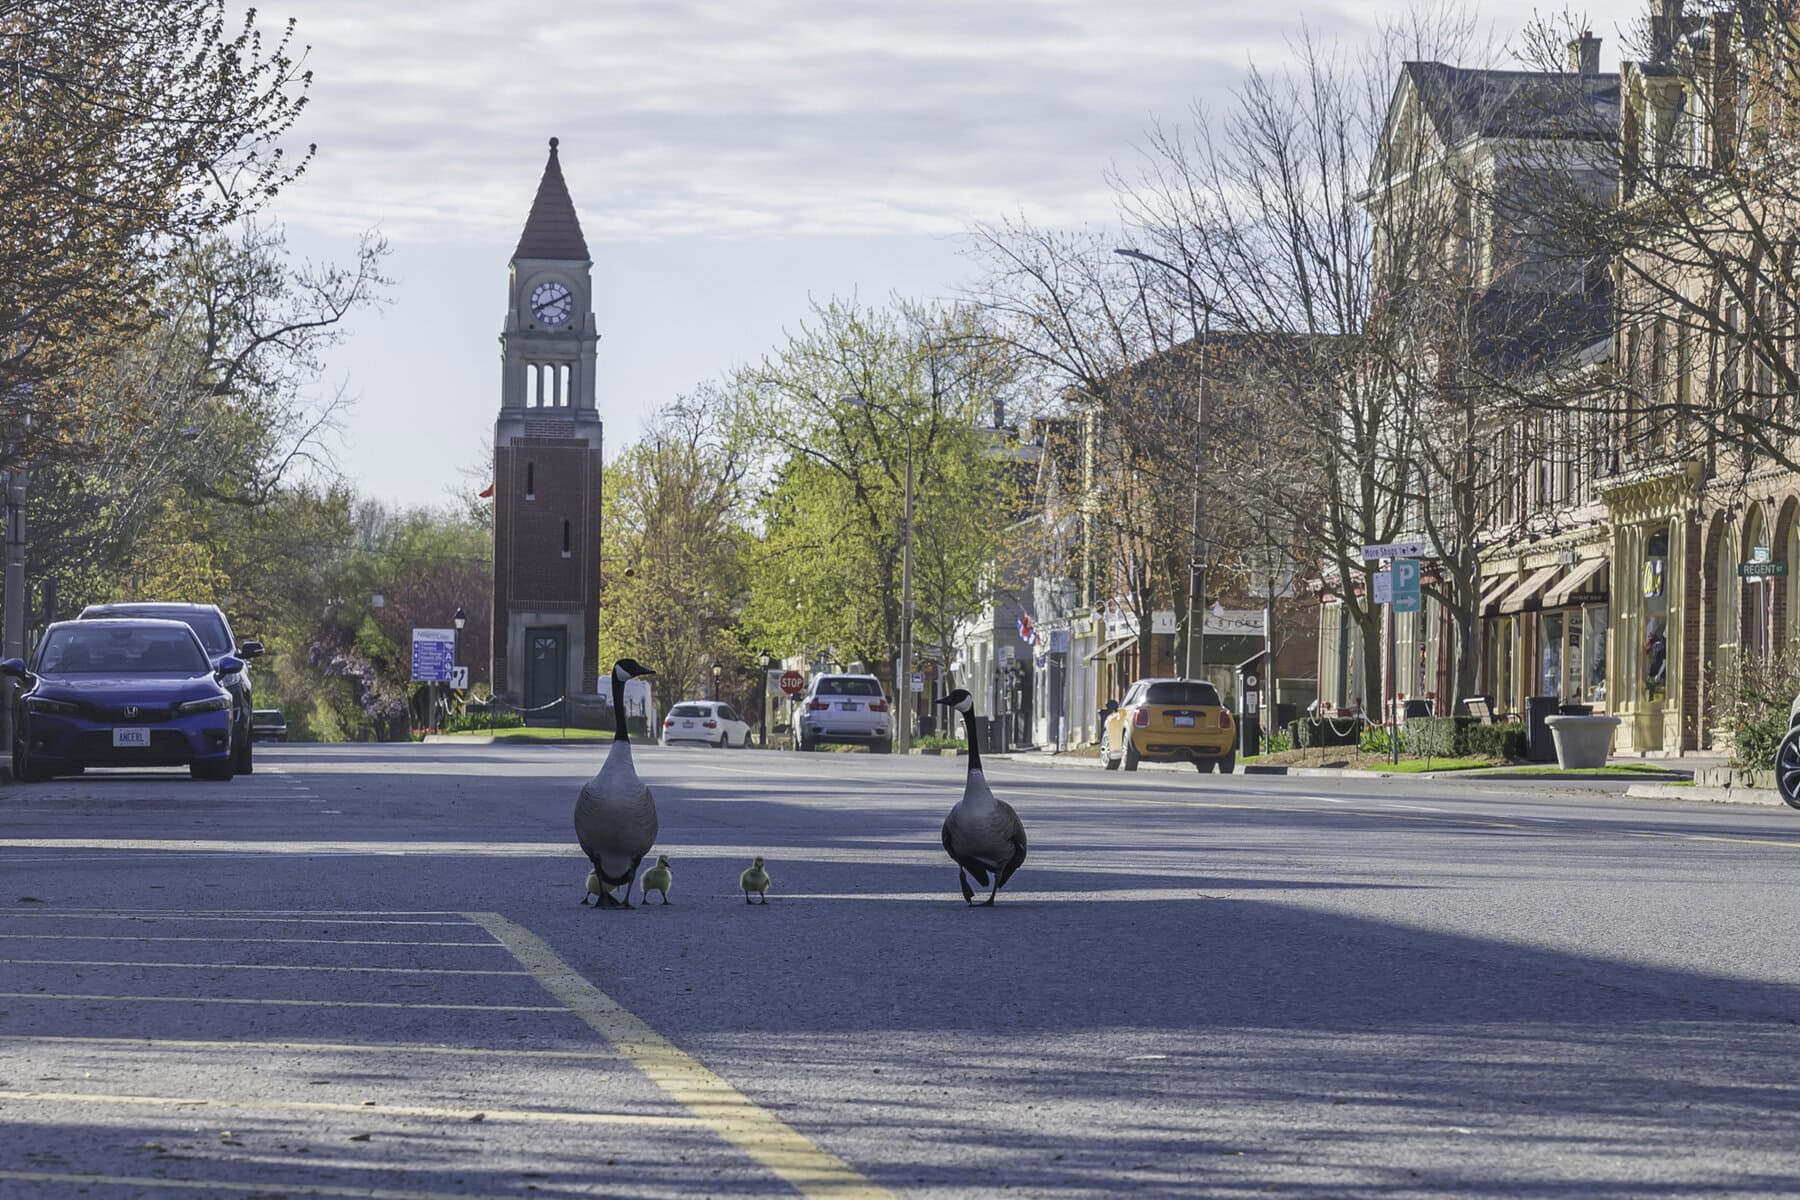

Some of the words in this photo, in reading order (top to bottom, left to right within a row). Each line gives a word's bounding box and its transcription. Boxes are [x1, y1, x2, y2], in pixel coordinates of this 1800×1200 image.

[1743, 564, 1776, 575] REGENT
[1399, 564, 1414, 587] P
[781, 678, 803, 688] STOP
